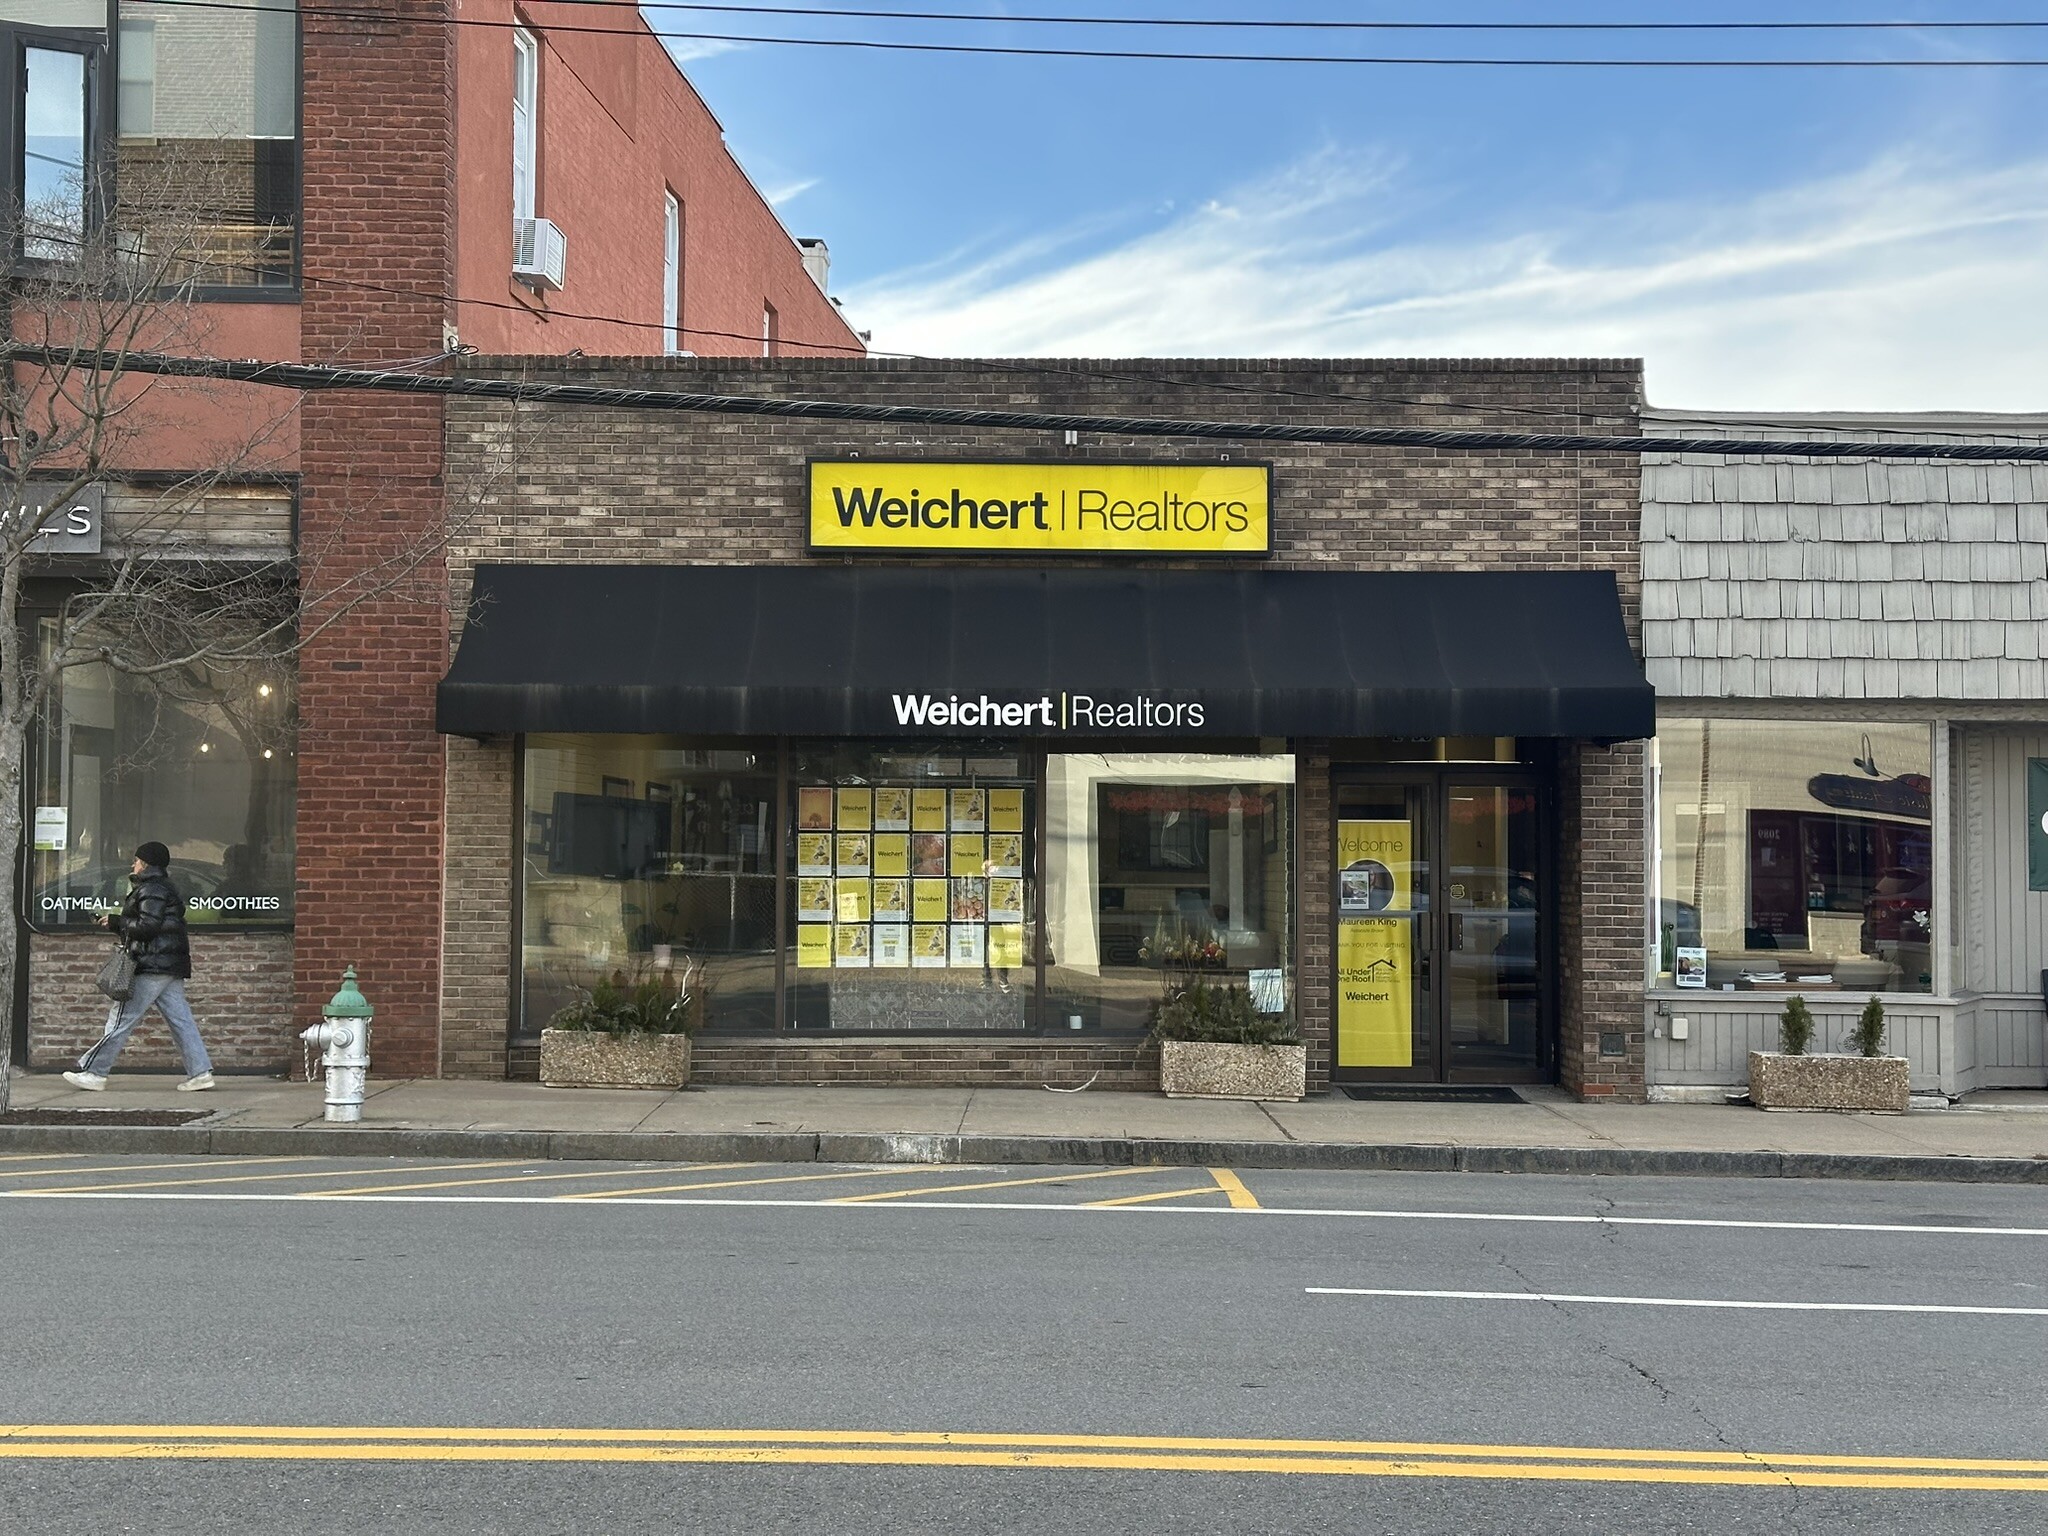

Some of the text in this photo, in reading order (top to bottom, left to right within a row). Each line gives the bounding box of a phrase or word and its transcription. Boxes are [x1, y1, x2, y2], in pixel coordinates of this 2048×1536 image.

[1078, 489, 1249, 532] Realtors
[1072, 695, 1205, 727] Realtors
[841, 804, 867, 812] Weichert
[41, 896, 280, 910] OATMEAL SMOOTHIES
[916, 895, 943, 903] Weichert
[1377, 917, 1397, 928] King
[1347, 968, 1371, 976] Under
[1352, 975, 1371, 983] Roof
[1345, 991, 1390, 1001] Weichert
